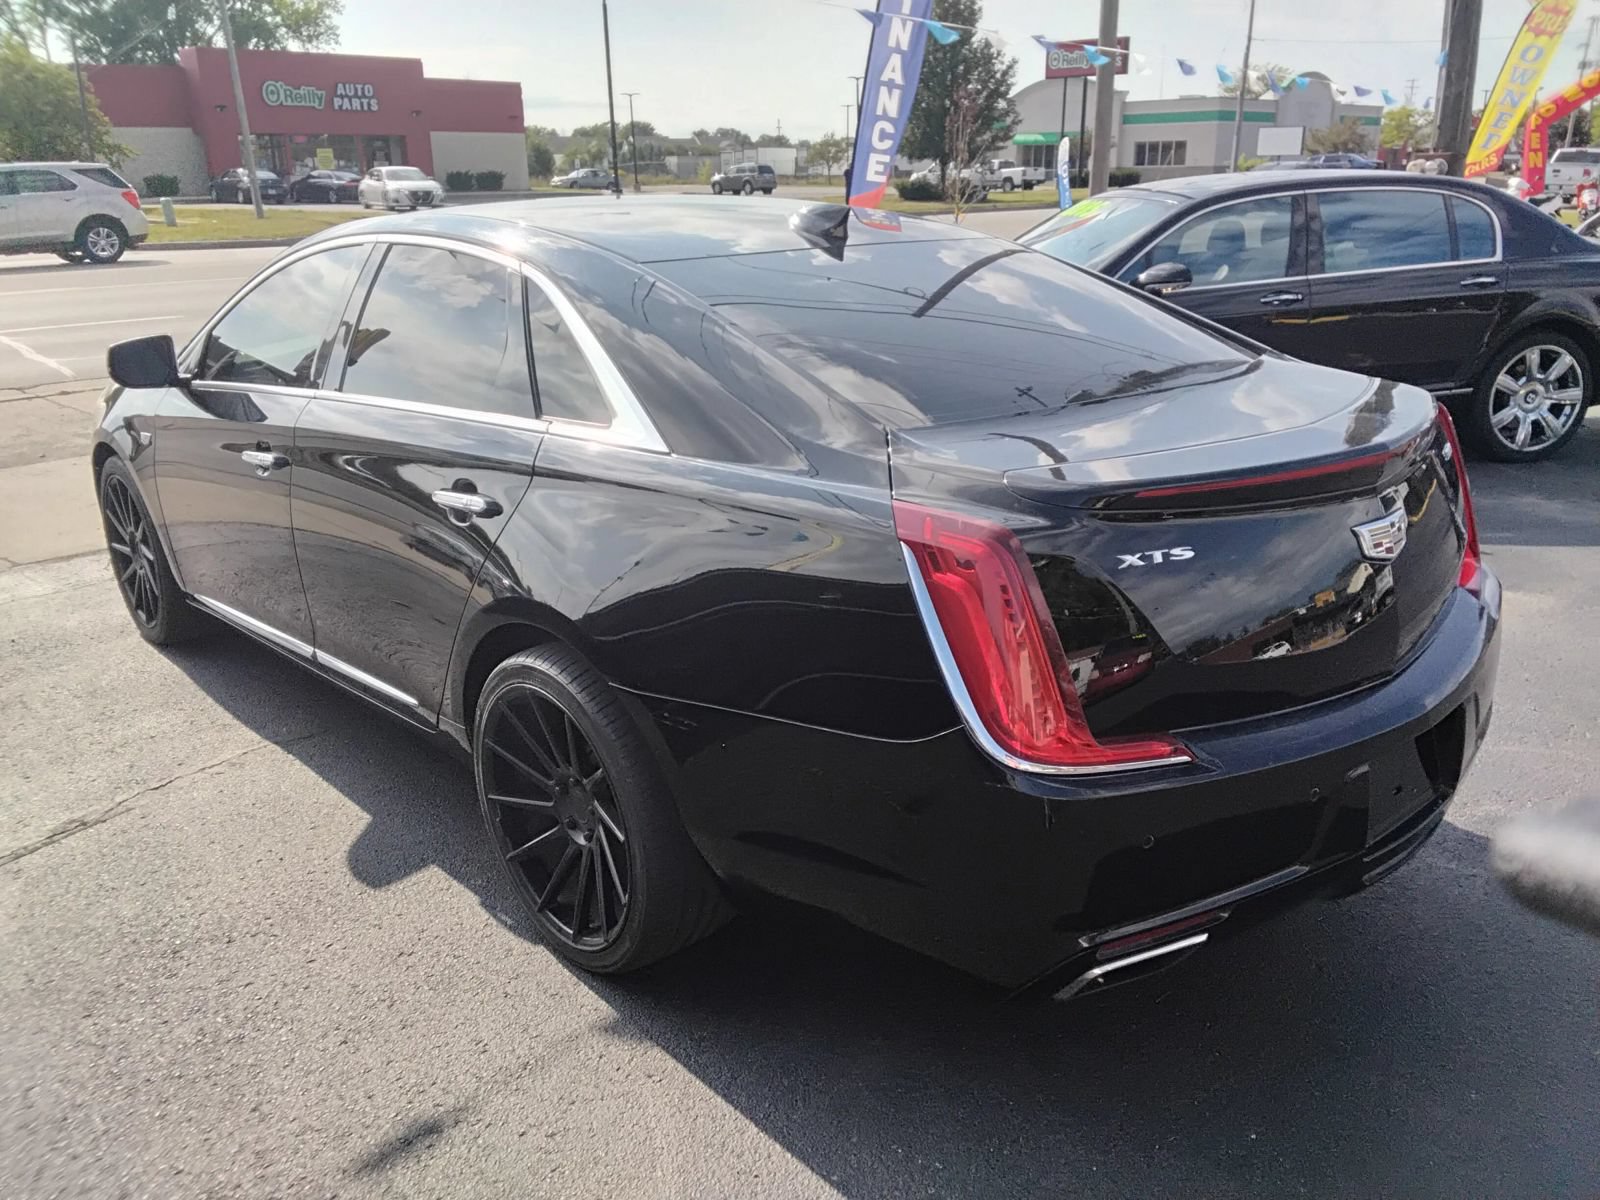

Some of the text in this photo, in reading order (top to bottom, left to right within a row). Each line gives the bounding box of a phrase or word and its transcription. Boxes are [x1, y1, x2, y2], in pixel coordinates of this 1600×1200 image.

[263, 81, 325, 109] O'Reilly
[336, 83, 373, 97] AUTO
[333, 97, 379, 111] PARTS
[1528, 102, 1557, 168] OPEN
[1116, 546, 1195, 569] XTS
